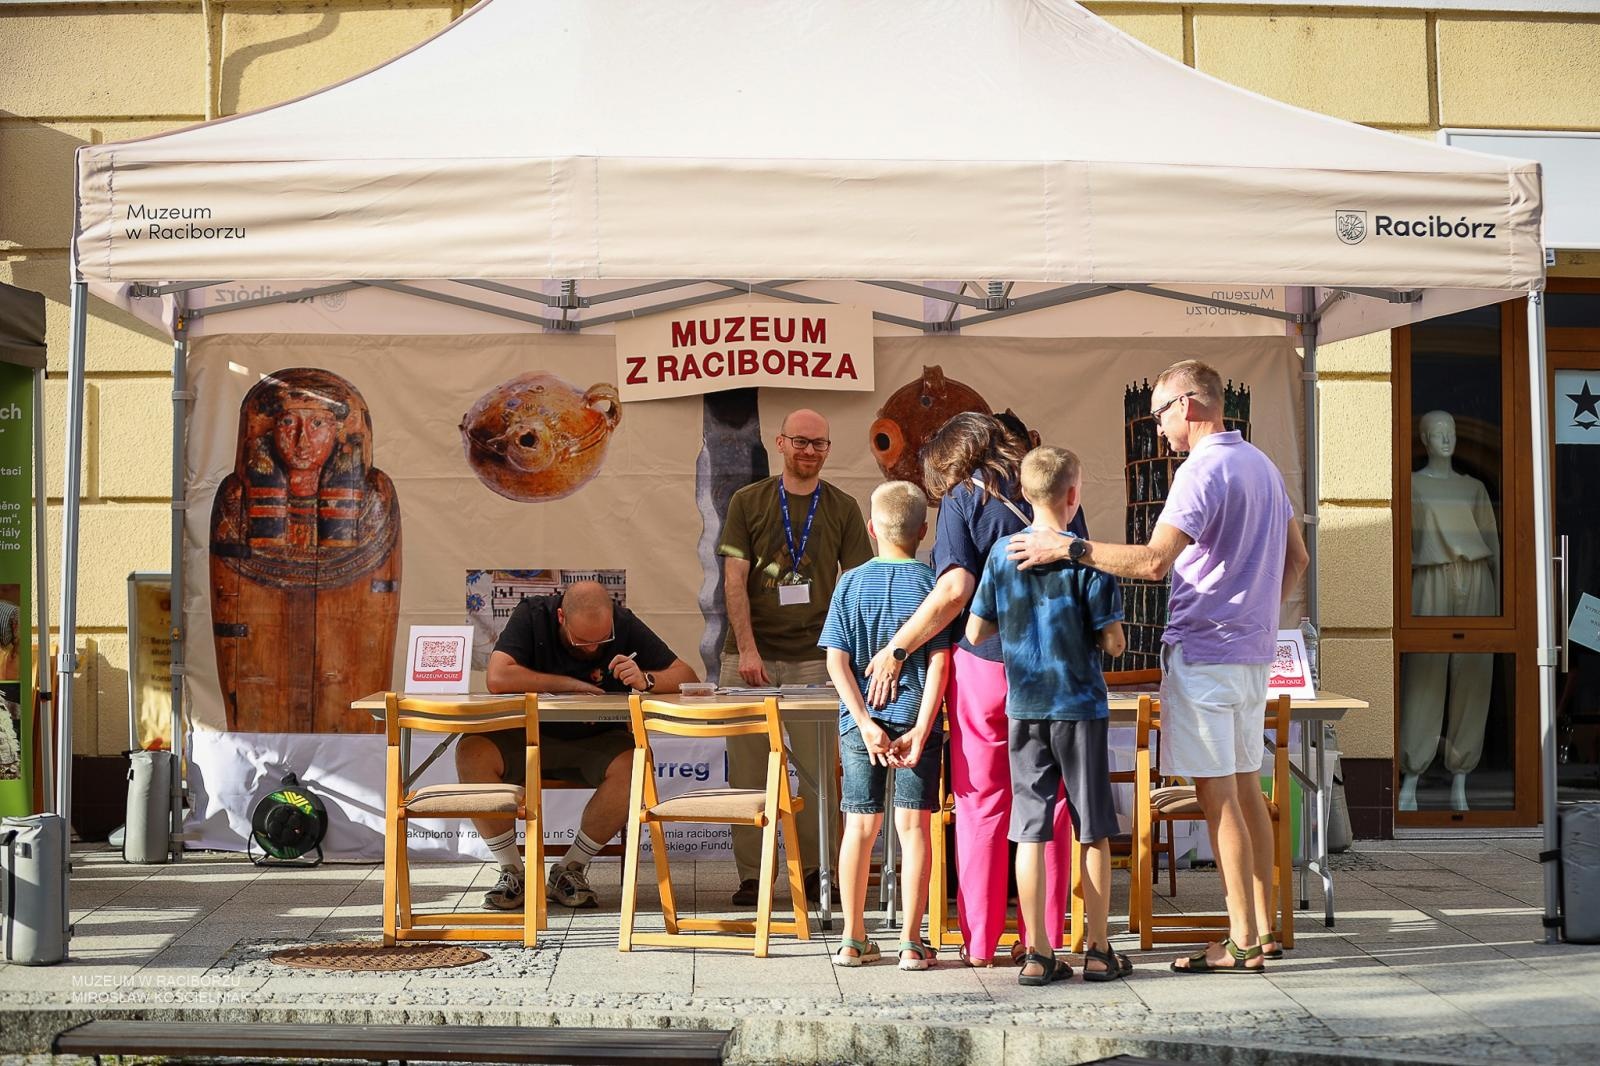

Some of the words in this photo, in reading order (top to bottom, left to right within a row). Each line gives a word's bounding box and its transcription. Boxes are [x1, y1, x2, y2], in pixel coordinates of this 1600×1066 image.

[126, 204, 211, 220] Muzeum
[125, 228, 142, 239] w
[149, 223, 246, 239] Raciborzu
[1375, 215, 1497, 238] Racibórz
[671, 316, 827, 348] MUZEUM
[626, 356, 648, 385] Z
[657, 349, 858, 382] RACIBORZA
[0, 403, 22, 420] ch
[0, 466, 22, 476] taci
[654, 762, 710, 781] rreg
[406, 830, 454, 840] akupiono
[700, 841, 734, 850] Fundu
